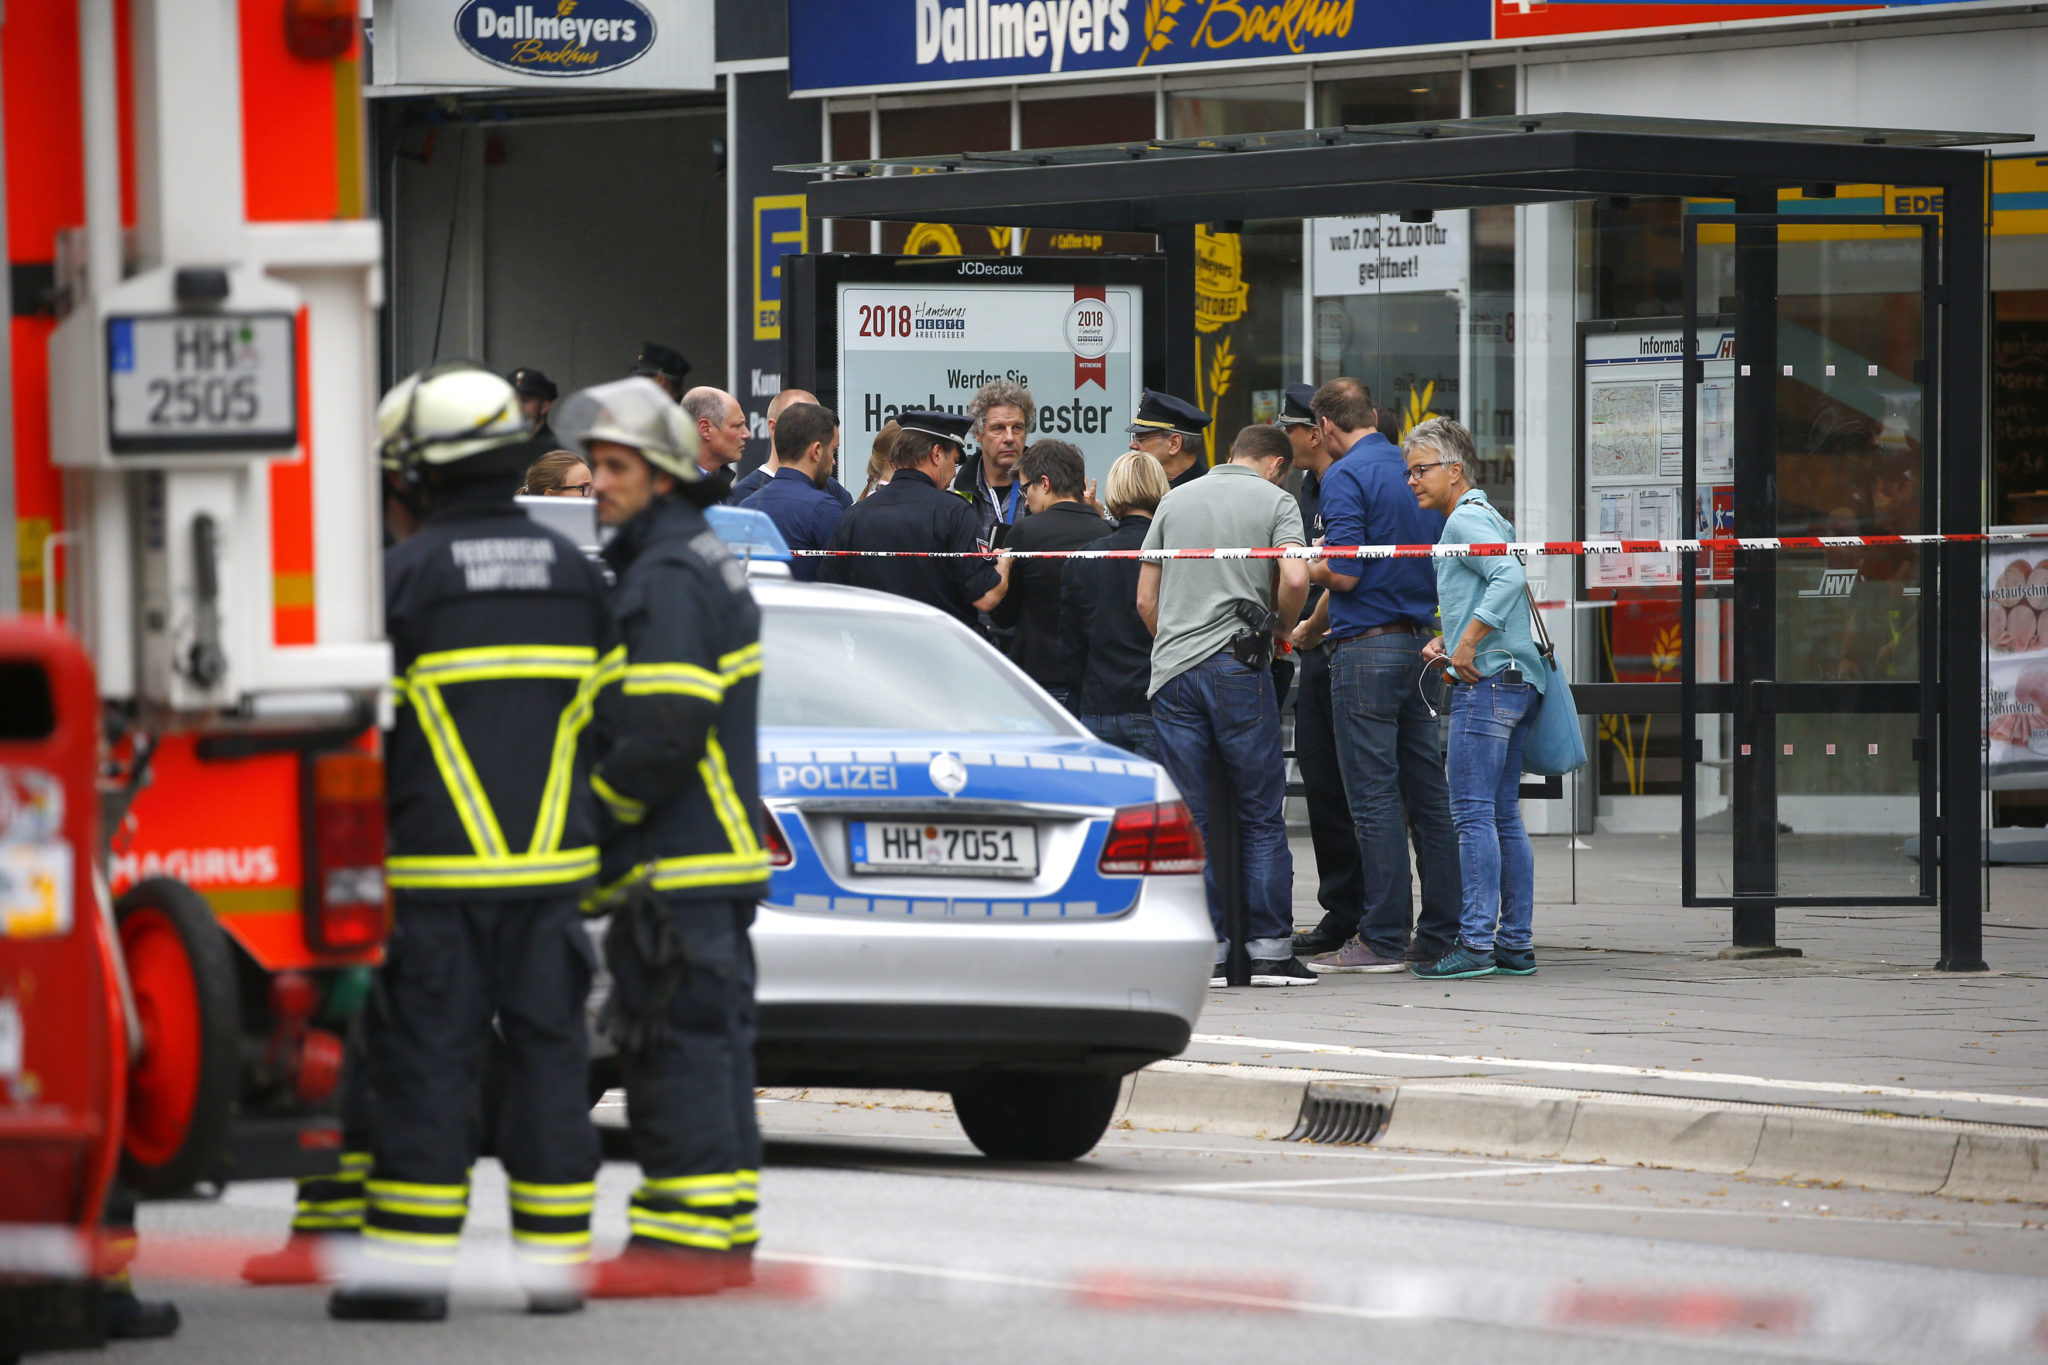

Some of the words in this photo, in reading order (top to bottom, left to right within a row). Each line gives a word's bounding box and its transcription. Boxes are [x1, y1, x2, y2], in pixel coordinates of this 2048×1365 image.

[477, 5, 637, 47] Dallmeyers
[915, 0, 1130, 72] Dallmeyers
[1190, 0, 1356, 54] Backhus
[510, 37, 600, 67] Backhus
[1895, 195, 1944, 213] EDE
[1425, 222, 1447, 246] Uhr
[957, 261, 1024, 276] JCDecaux
[858, 304, 912, 338] 2018
[915, 301, 967, 318] Hamburgs
[1077, 310, 1104, 327] 2018
[915, 319, 965, 330] BESTE
[915, 331, 965, 339] ARBEITGEBER
[174, 323, 236, 371] HH
[1006, 369, 1028, 389] Sie
[147, 376, 260, 425] 2505
[1030, 397, 1113, 434] ester
[1824, 575, 1857, 595] HVV
[776, 765, 898, 792] POLIZEI
[883, 826, 923, 860] HH
[942, 829, 1019, 863] 7051
[108, 845, 278, 889] MAGIRUS
